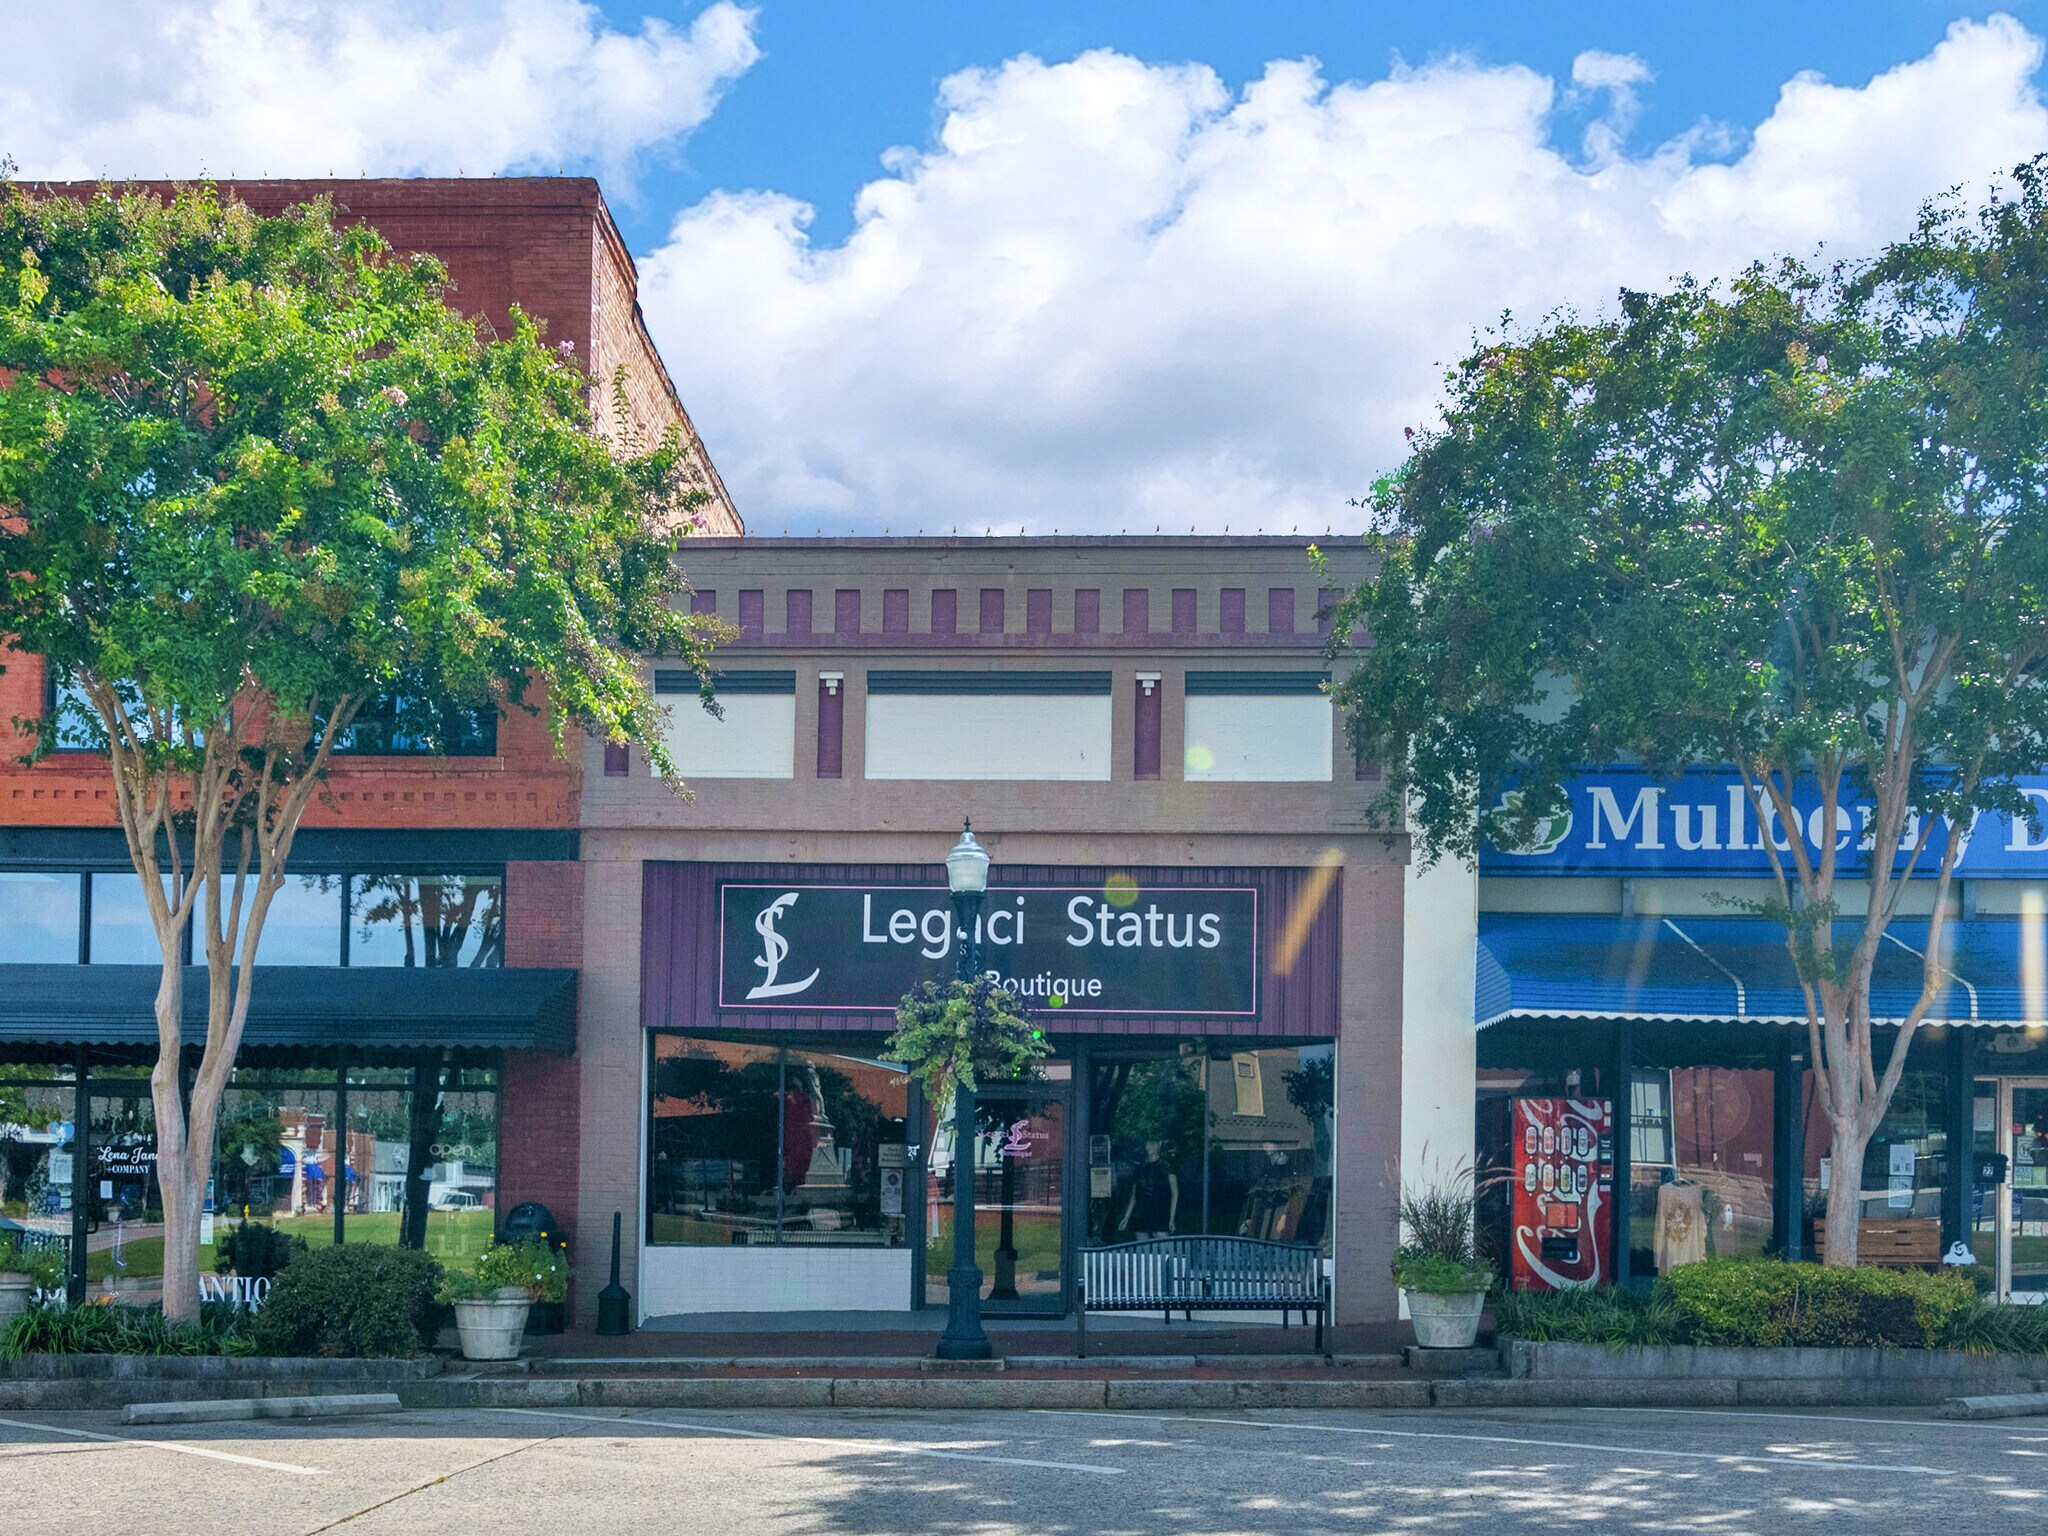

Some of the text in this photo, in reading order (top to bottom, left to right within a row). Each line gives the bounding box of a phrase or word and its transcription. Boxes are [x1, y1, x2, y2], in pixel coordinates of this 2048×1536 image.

[1066, 896, 1222, 949] Status
[97, 1146, 130, 1163] Lena
[430, 1143, 473, 1158] open
